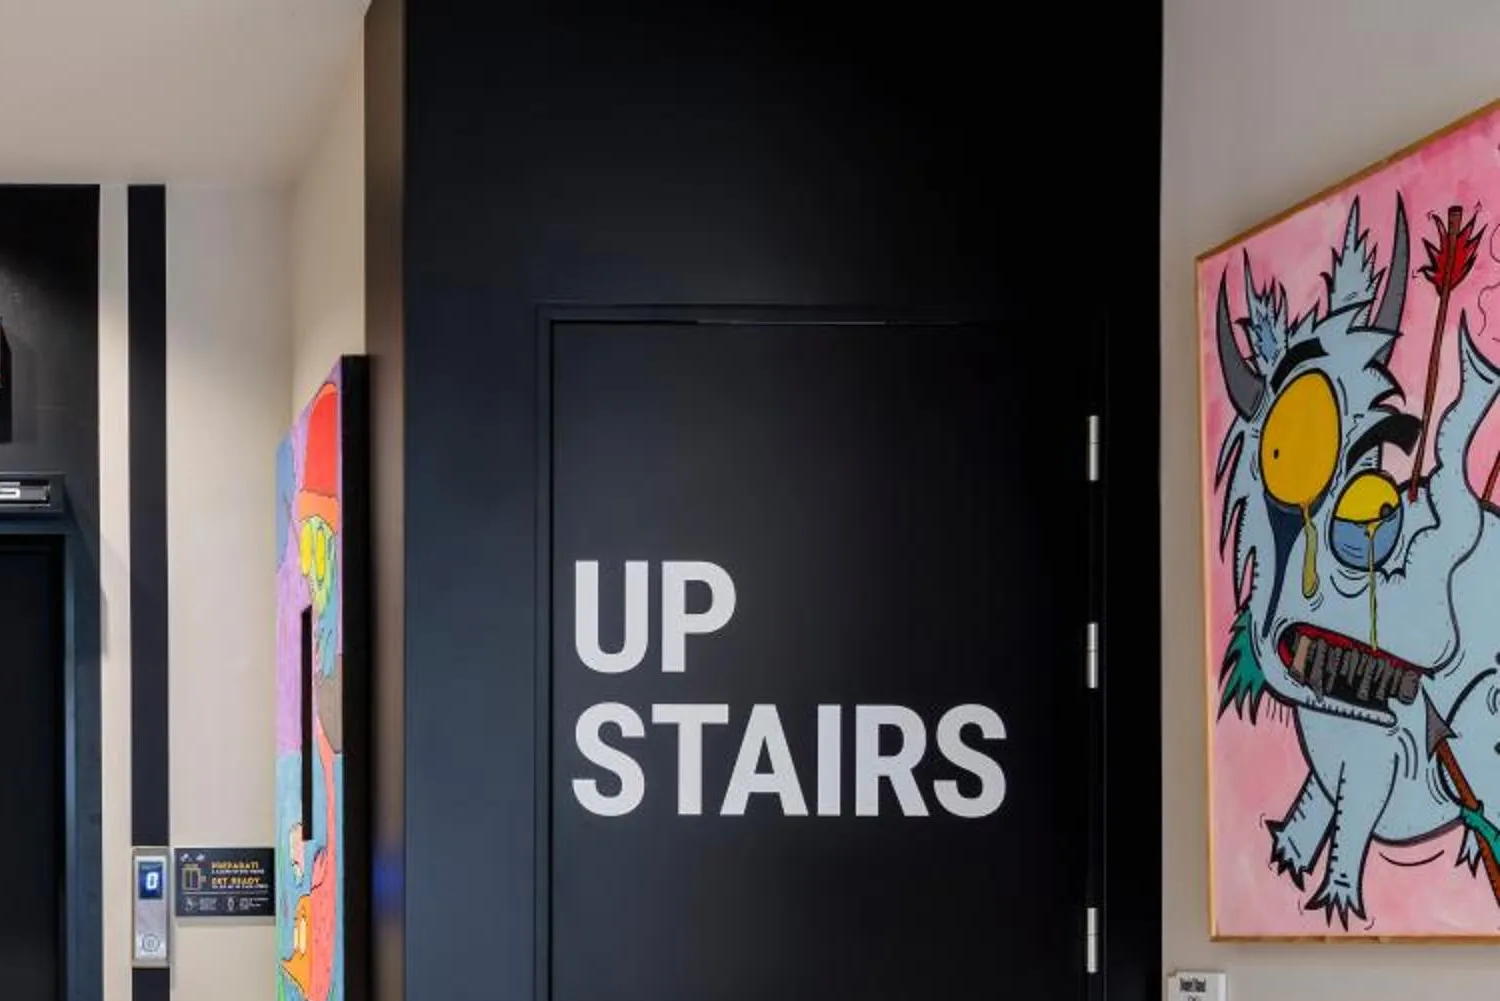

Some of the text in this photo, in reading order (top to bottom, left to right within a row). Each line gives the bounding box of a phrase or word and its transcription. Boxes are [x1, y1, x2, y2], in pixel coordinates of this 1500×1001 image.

[574, 559, 737, 674] UP
[572, 702, 1007, 818] STAIRS
[146, 872, 159, 890] 0
